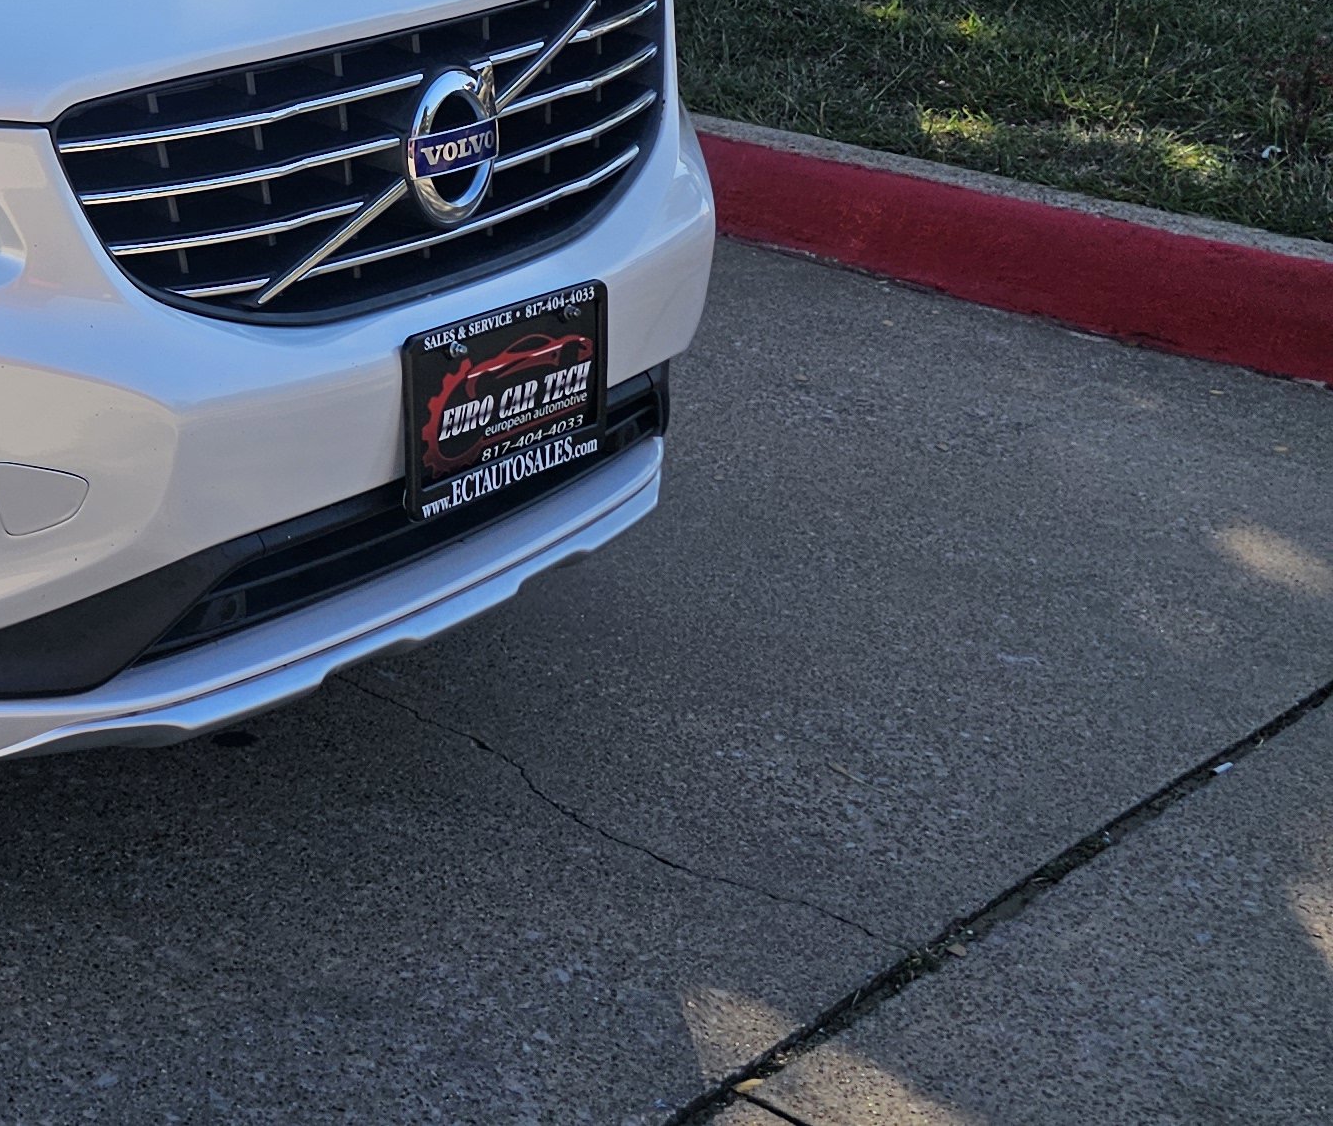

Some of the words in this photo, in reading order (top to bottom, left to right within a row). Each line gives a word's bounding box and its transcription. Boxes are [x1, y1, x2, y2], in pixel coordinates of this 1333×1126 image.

[421, 130, 494, 166] VOLVO
[424, 328, 456, 351] SALES
[457, 327, 467, 339] &
[468, 310, 513, 336] SERVICE
[525, 286, 595, 319] 817-404-4033
[439, 394, 494, 442] EURO
[499, 380, 538, 419] CAR
[541, 360, 592, 404] TECH
[485, 411, 532, 438] european
[533, 391, 588, 419] automotive
[481, 414, 584, 462] 817-404-4033
[422, 435, 598, 519] www.ECTAUTOSALES.com
